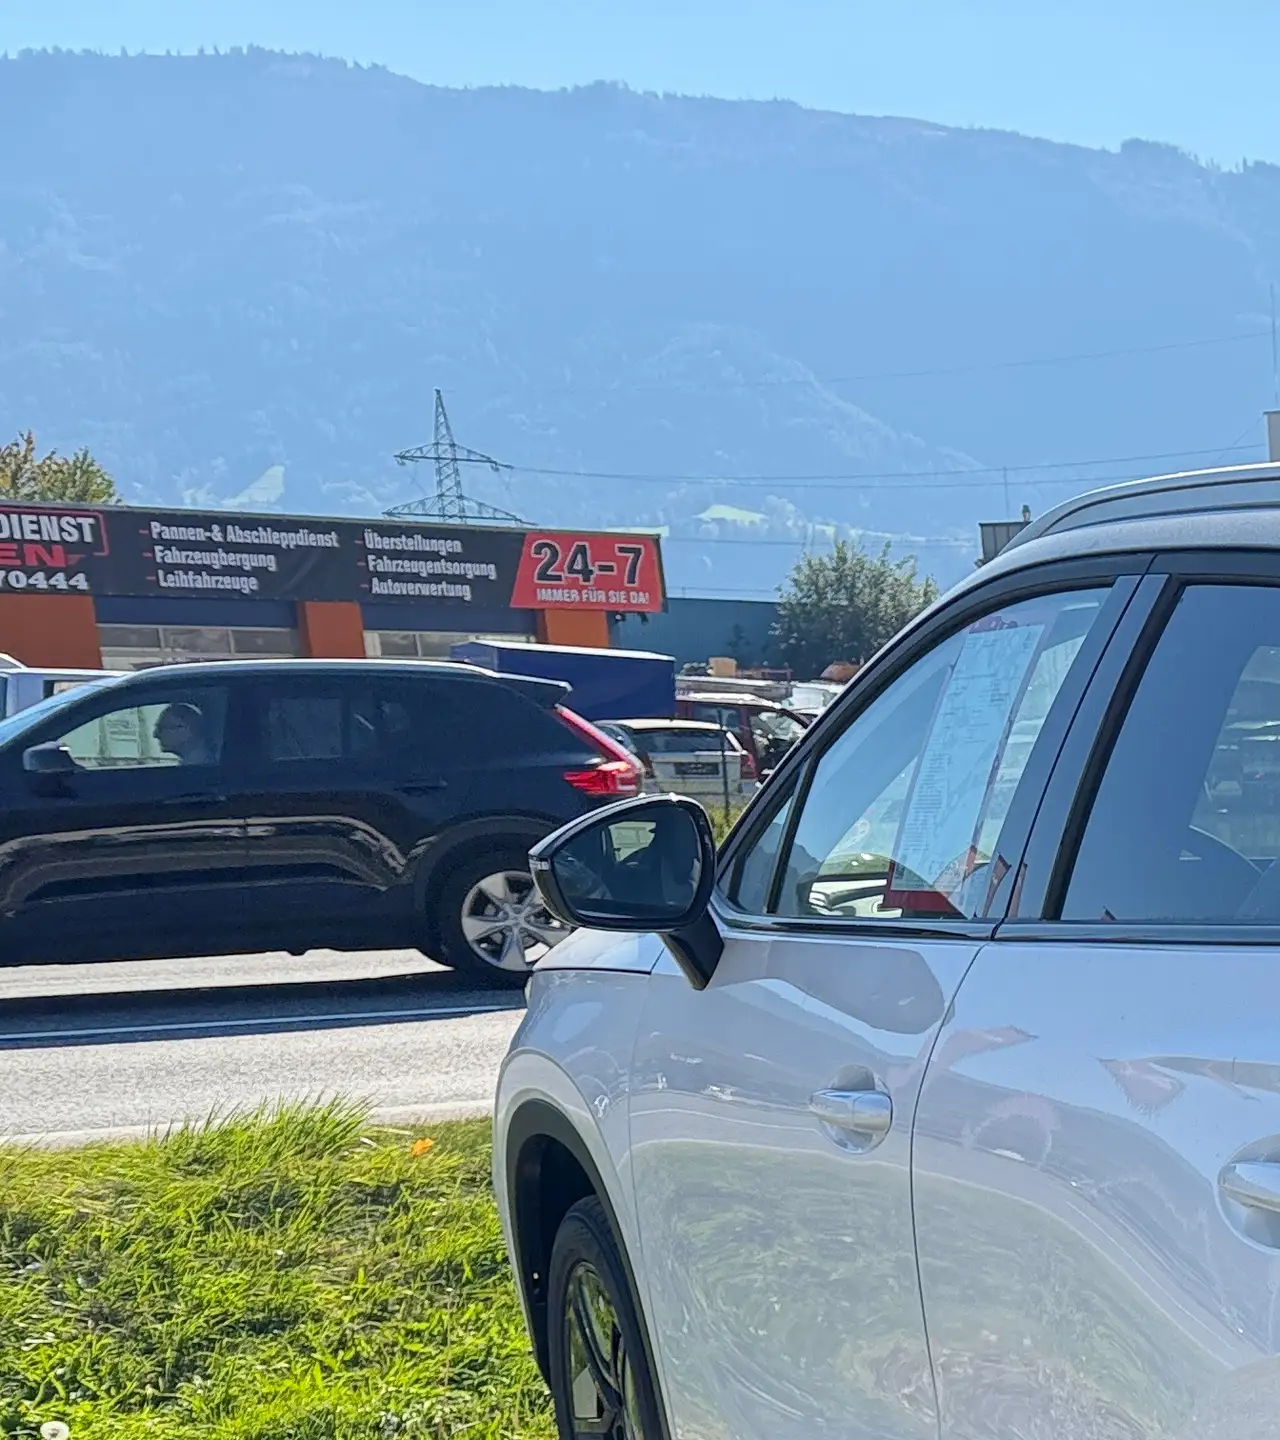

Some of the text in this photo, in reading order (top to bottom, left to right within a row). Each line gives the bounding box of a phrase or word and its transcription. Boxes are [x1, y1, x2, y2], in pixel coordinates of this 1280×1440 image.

[0, 513, 96, 543] DIENST
[226, 524, 340, 549] Abschleppdienst
[363, 528, 463, 556] Überstellungen
[153, 545, 278, 572] Fahrzeugbergung
[367, 554, 497, 580] Fahrzeugentsorgung
[531, 539, 645, 587] 24-7
[157, 569, 260, 594] Leihfahrzeuge
[371, 577, 472, 601] Autoverwertung
[536, 587, 579, 602] IMMER
[581, 586, 606, 603] FÜR
[608, 590, 628, 604] SIE
